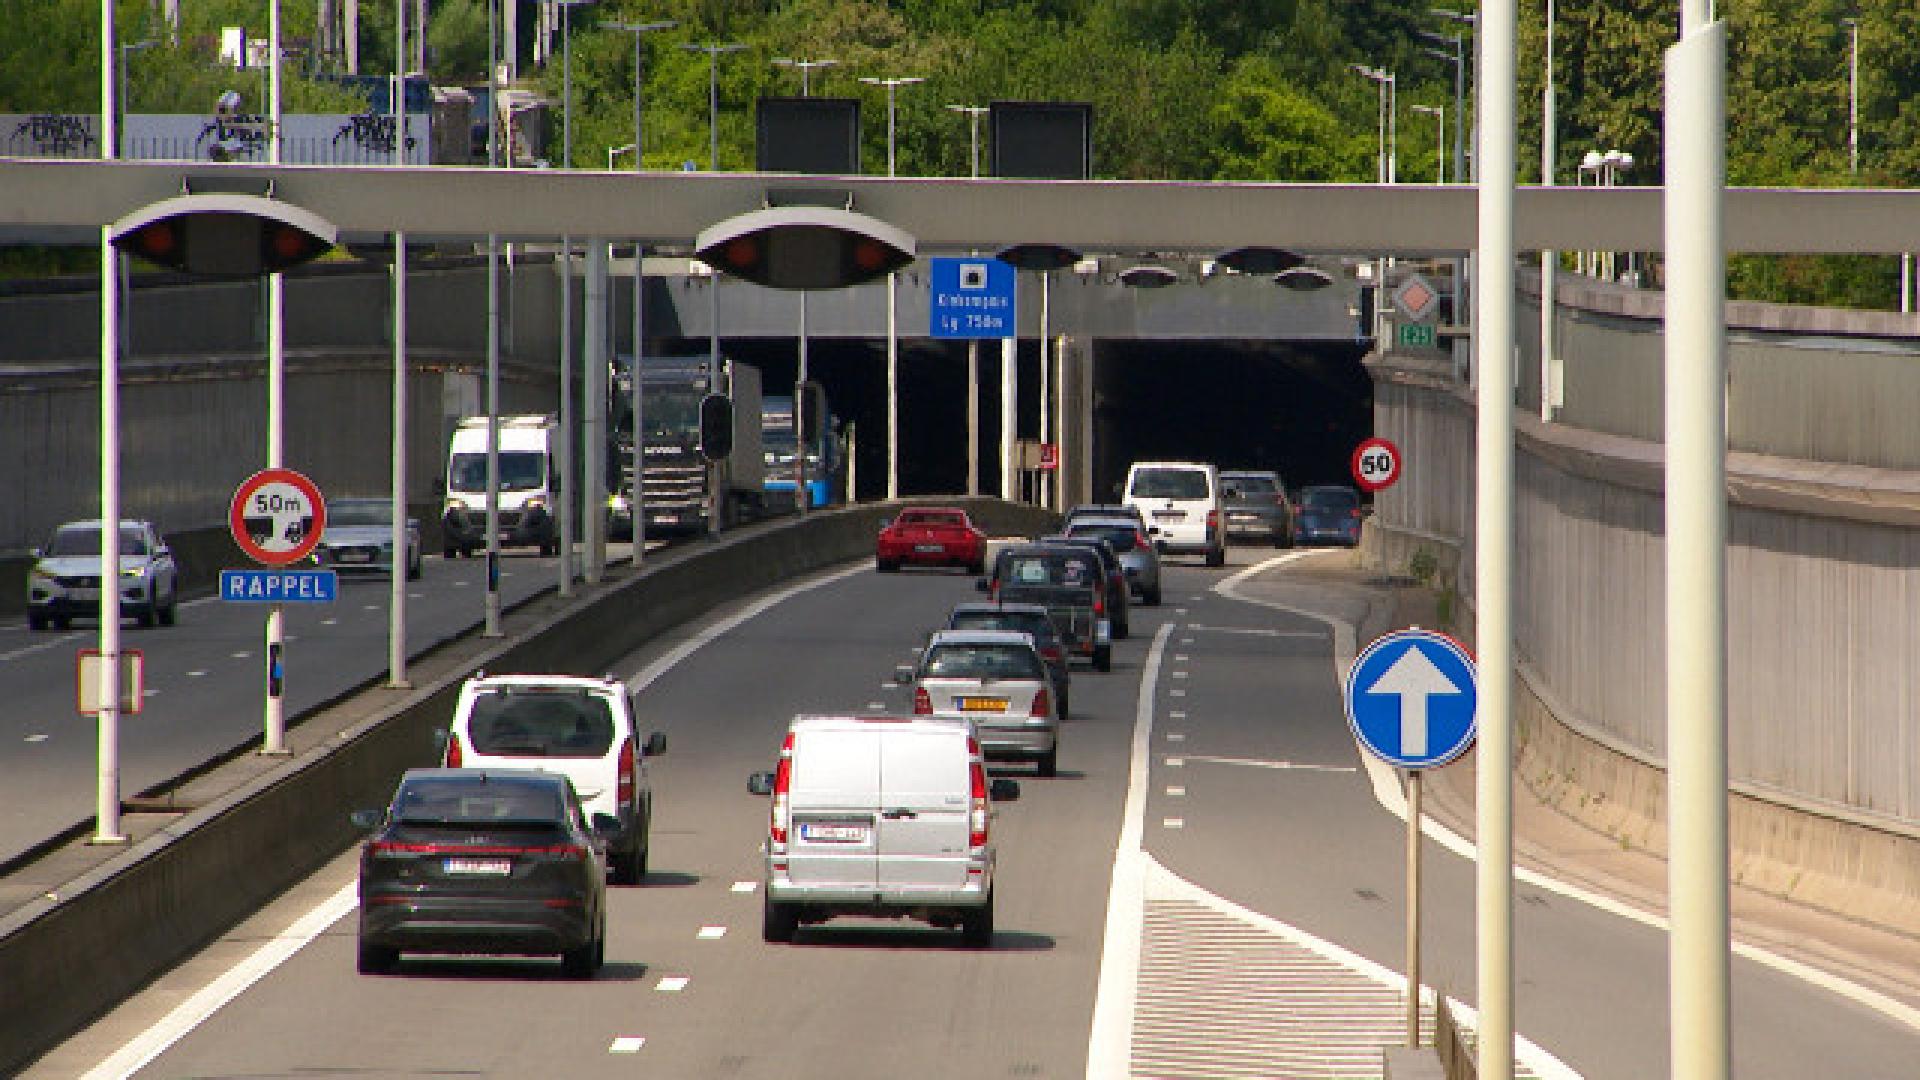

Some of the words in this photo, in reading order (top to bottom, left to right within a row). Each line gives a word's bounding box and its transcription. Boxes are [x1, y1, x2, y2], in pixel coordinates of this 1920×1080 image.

[1361, 453, 1391, 475] 50
[255, 494, 300, 513] 50m
[230, 575, 328, 598] RAPPEL
